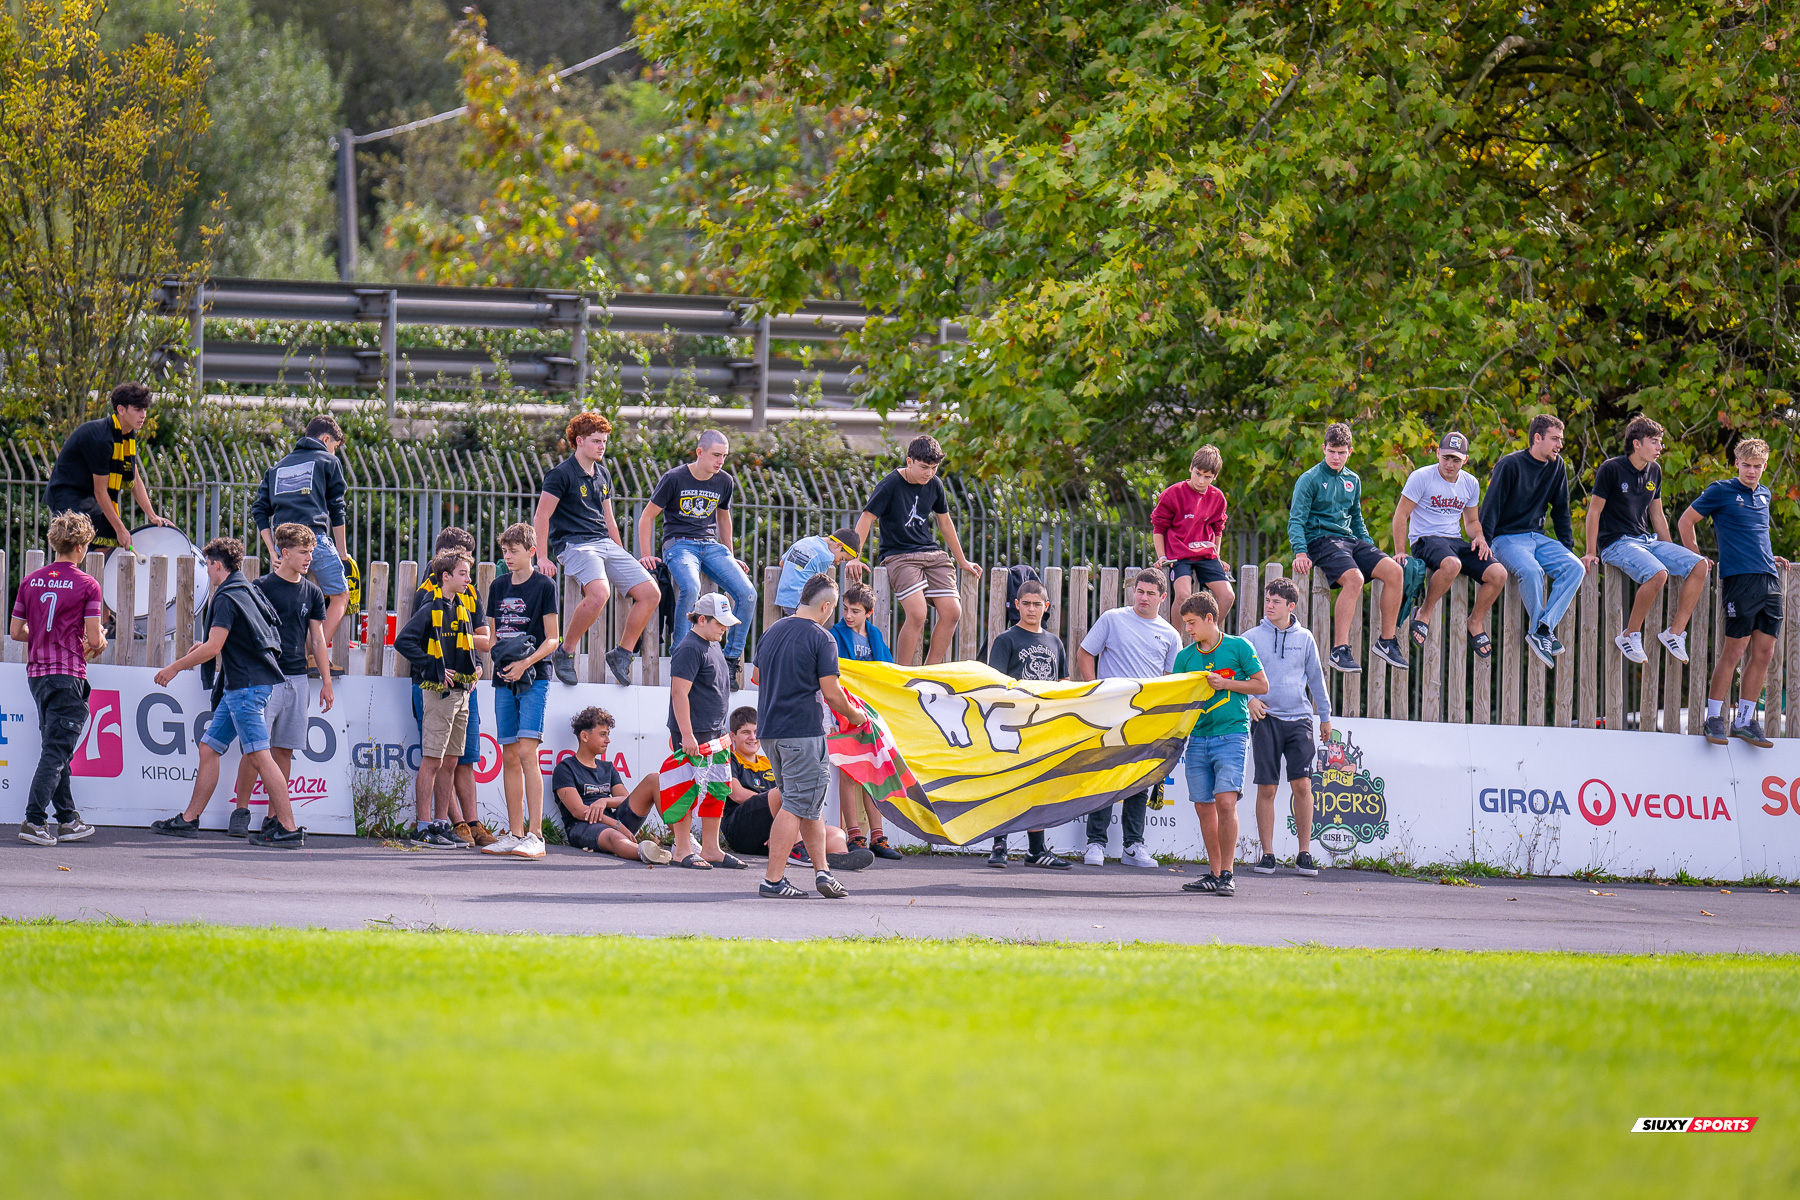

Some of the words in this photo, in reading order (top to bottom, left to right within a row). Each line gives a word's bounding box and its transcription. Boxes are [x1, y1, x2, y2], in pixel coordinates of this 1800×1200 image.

[48, 579, 74, 590] GALEA
[40, 591, 58, 632] 7
[352, 742, 423, 772] GIRO
[141, 765, 199, 781] KIROLA
[1311, 790, 1381, 817] IPER'S
[1479, 788, 1571, 815] GIROA
[1621, 792, 1732, 821] VEOLIA
